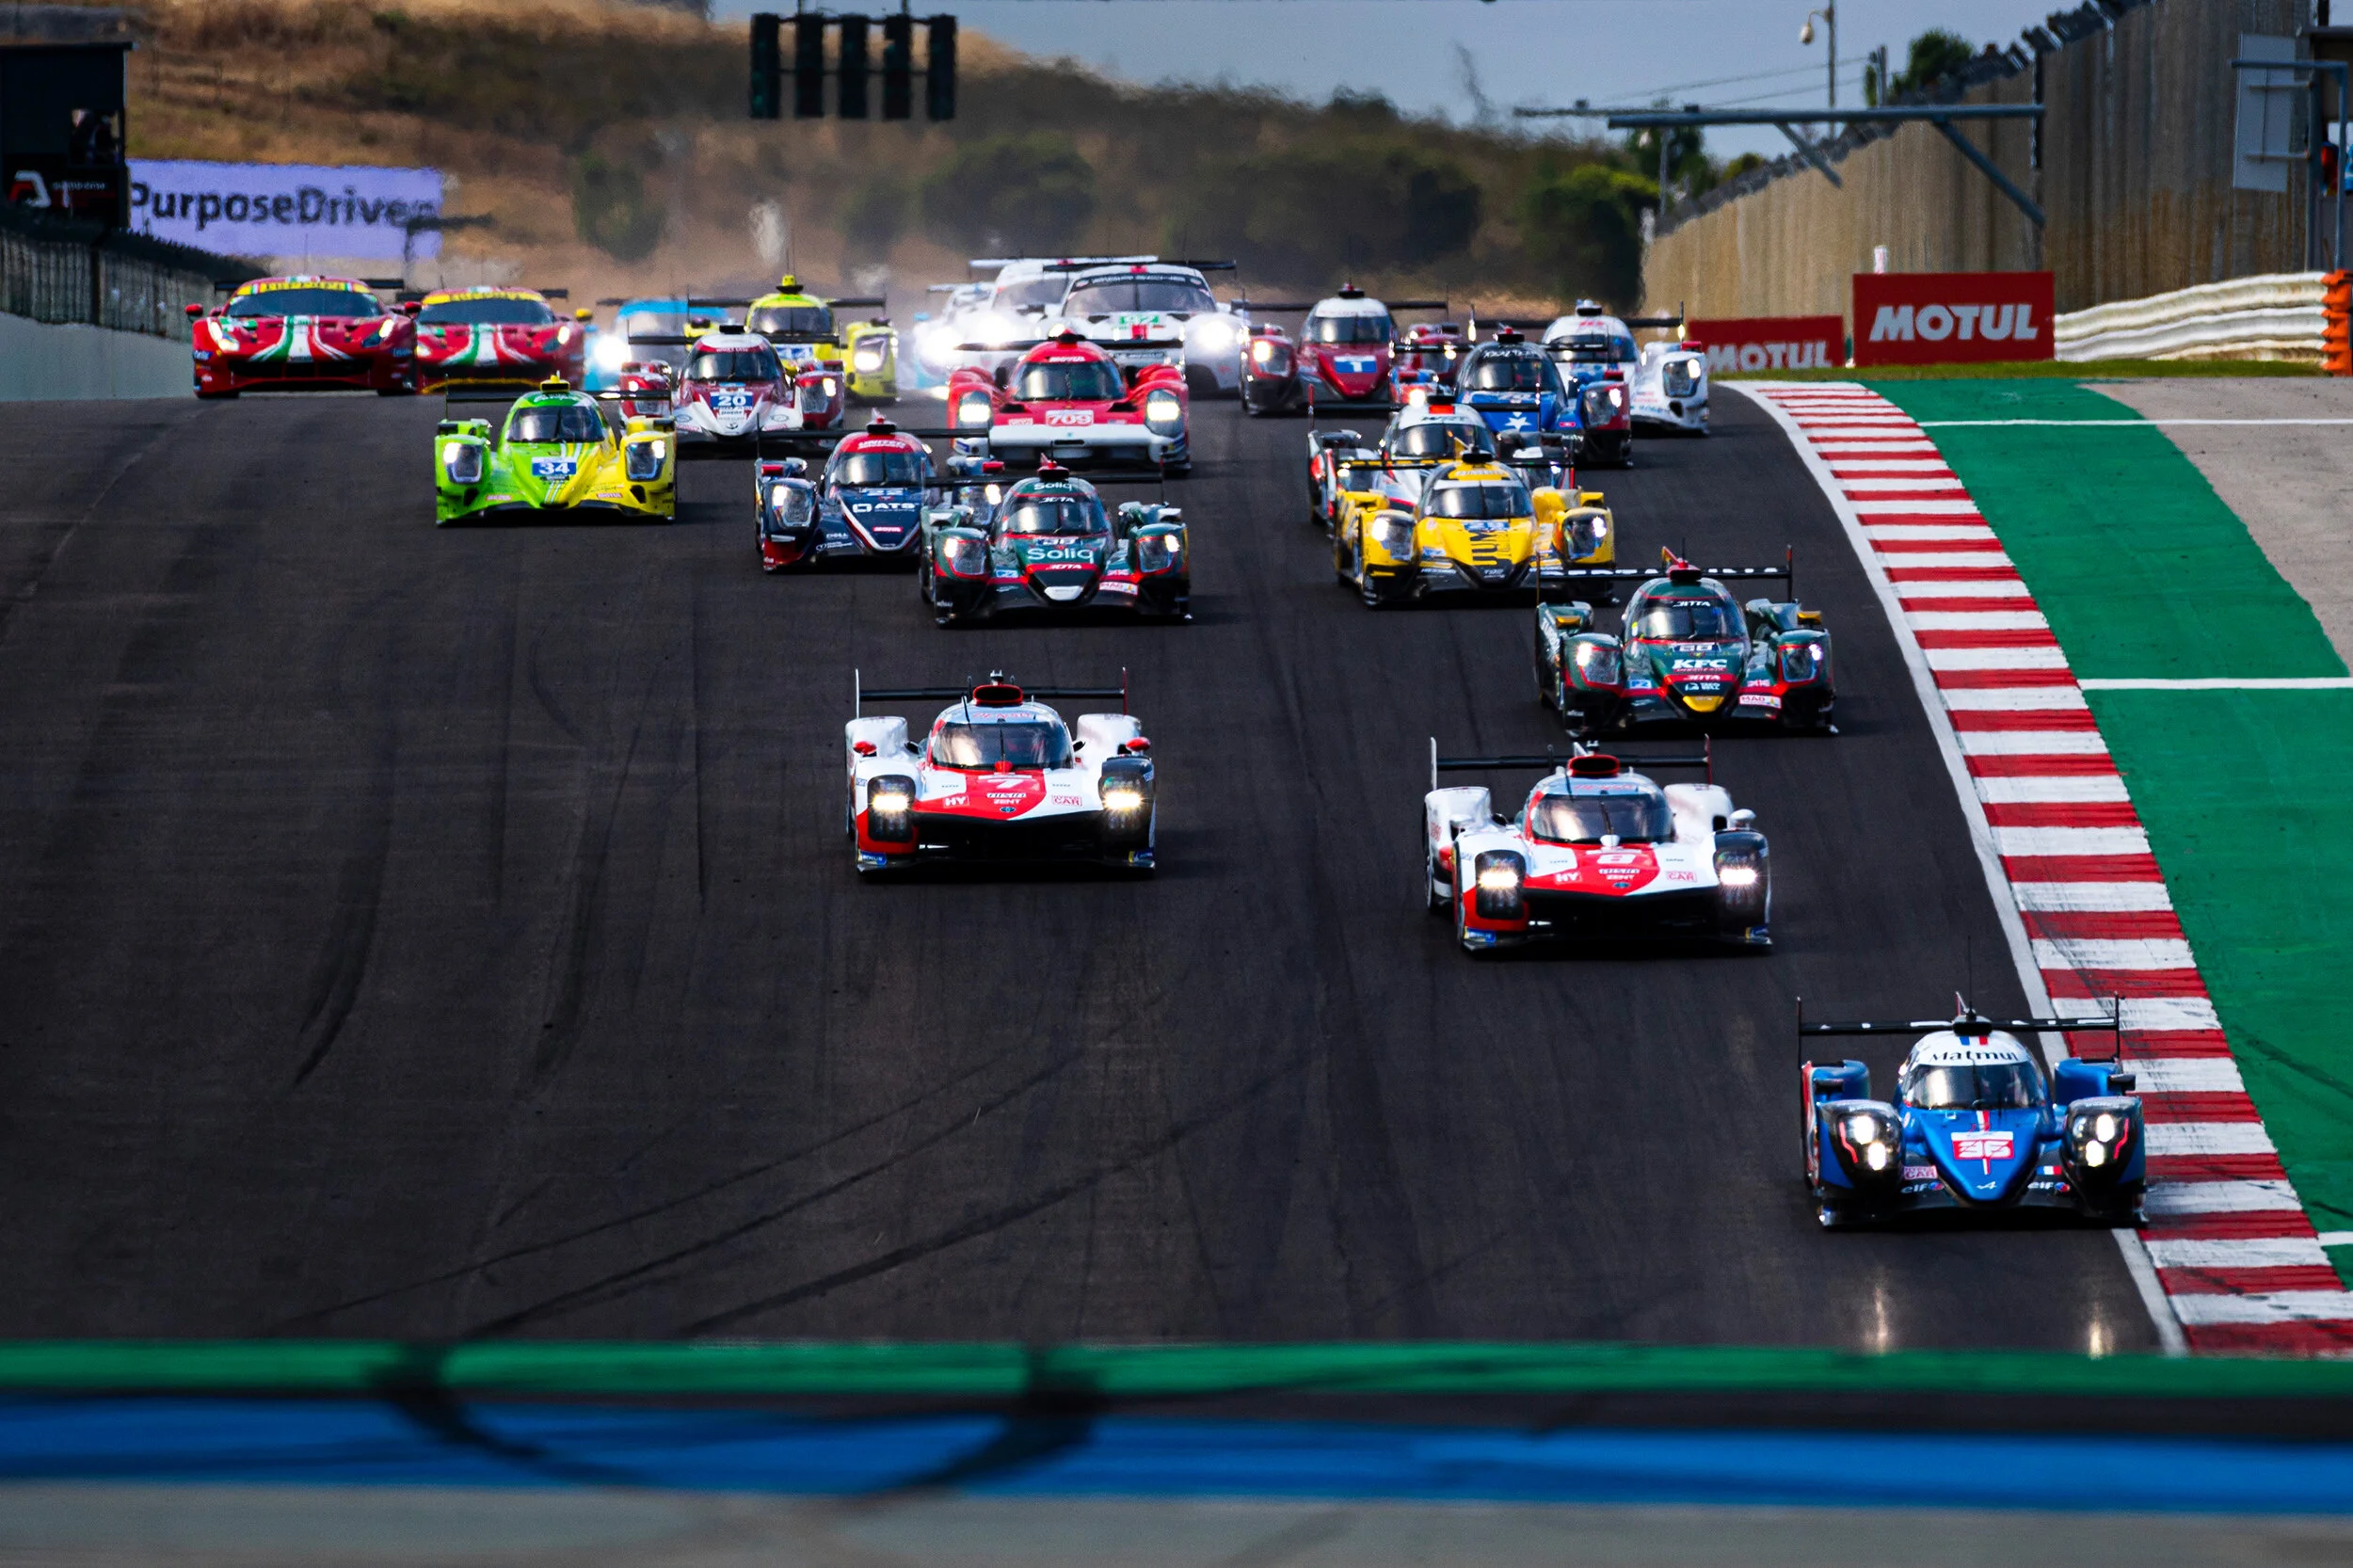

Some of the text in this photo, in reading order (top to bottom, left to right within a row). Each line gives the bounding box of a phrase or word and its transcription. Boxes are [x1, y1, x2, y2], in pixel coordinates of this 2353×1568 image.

[1868, 304, 2039, 342] MOTUL
[1706, 340, 1833, 373] MOTUL
[1350, 361, 1363, 373] 1
[717, 395, 746, 407] 20
[1048, 414, 1092, 424] 709
[538, 462, 570, 475] 34
[1034, 482, 1073, 491] Soliq
[1027, 548, 1095, 565] Soliq
[1672, 659, 1729, 669] KFC
[987, 778, 1025, 790] 7
[944, 797, 967, 808] HY
[1053, 798, 1080, 807] CAR
[1958, 1140, 2011, 1158] 36
